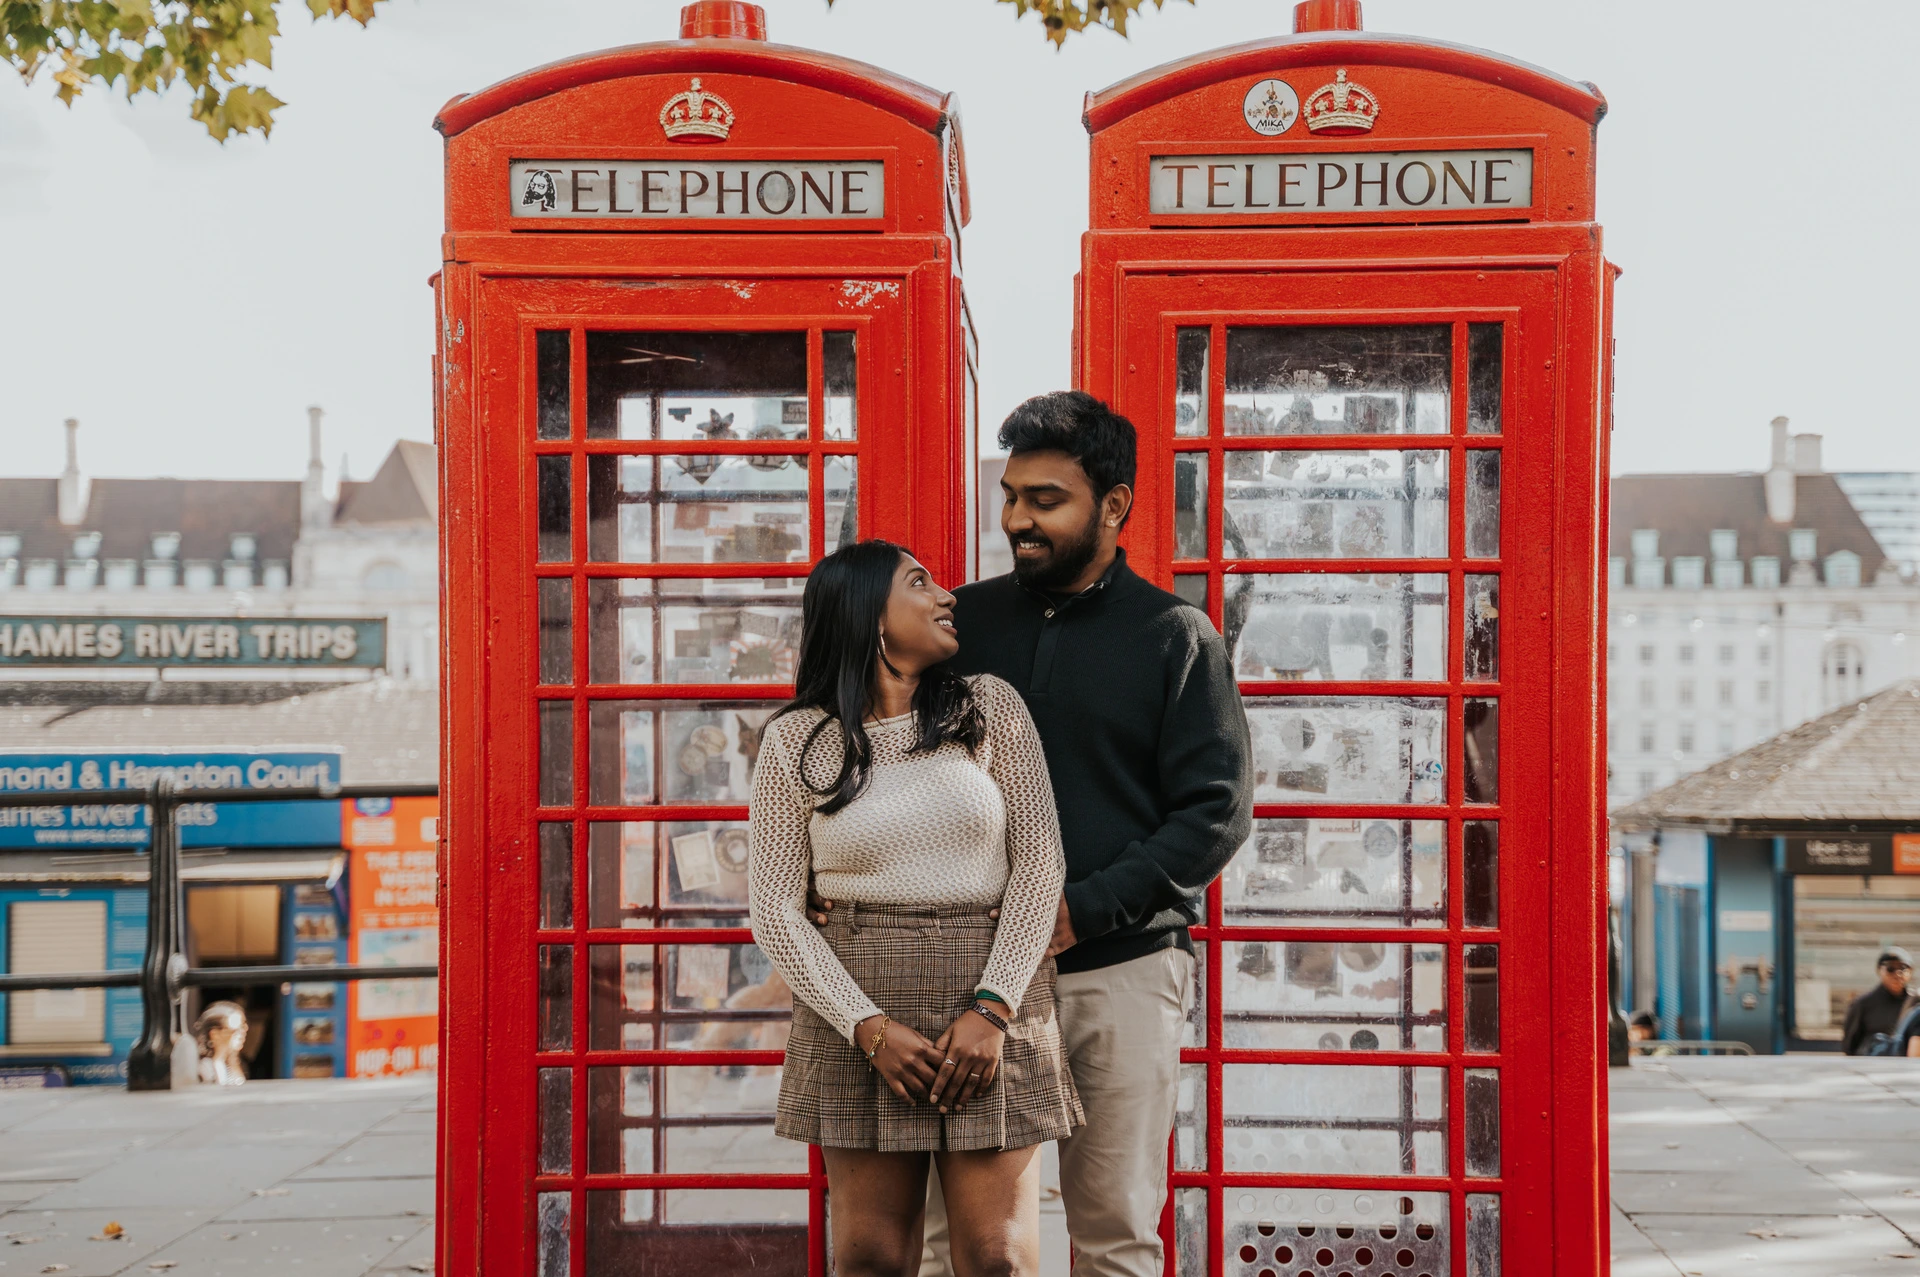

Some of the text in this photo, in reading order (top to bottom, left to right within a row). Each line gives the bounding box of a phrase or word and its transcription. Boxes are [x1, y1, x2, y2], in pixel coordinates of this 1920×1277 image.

[1255, 119, 1285, 130] MIKA
[1161, 159, 1513, 209] TELEPHONE
[134, 624, 240, 659] RIVER
[250, 624, 358, 660] TRIPS
[78, 759, 104, 790] &
[247, 758, 331, 790] Court
[71, 803, 140, 827] River
